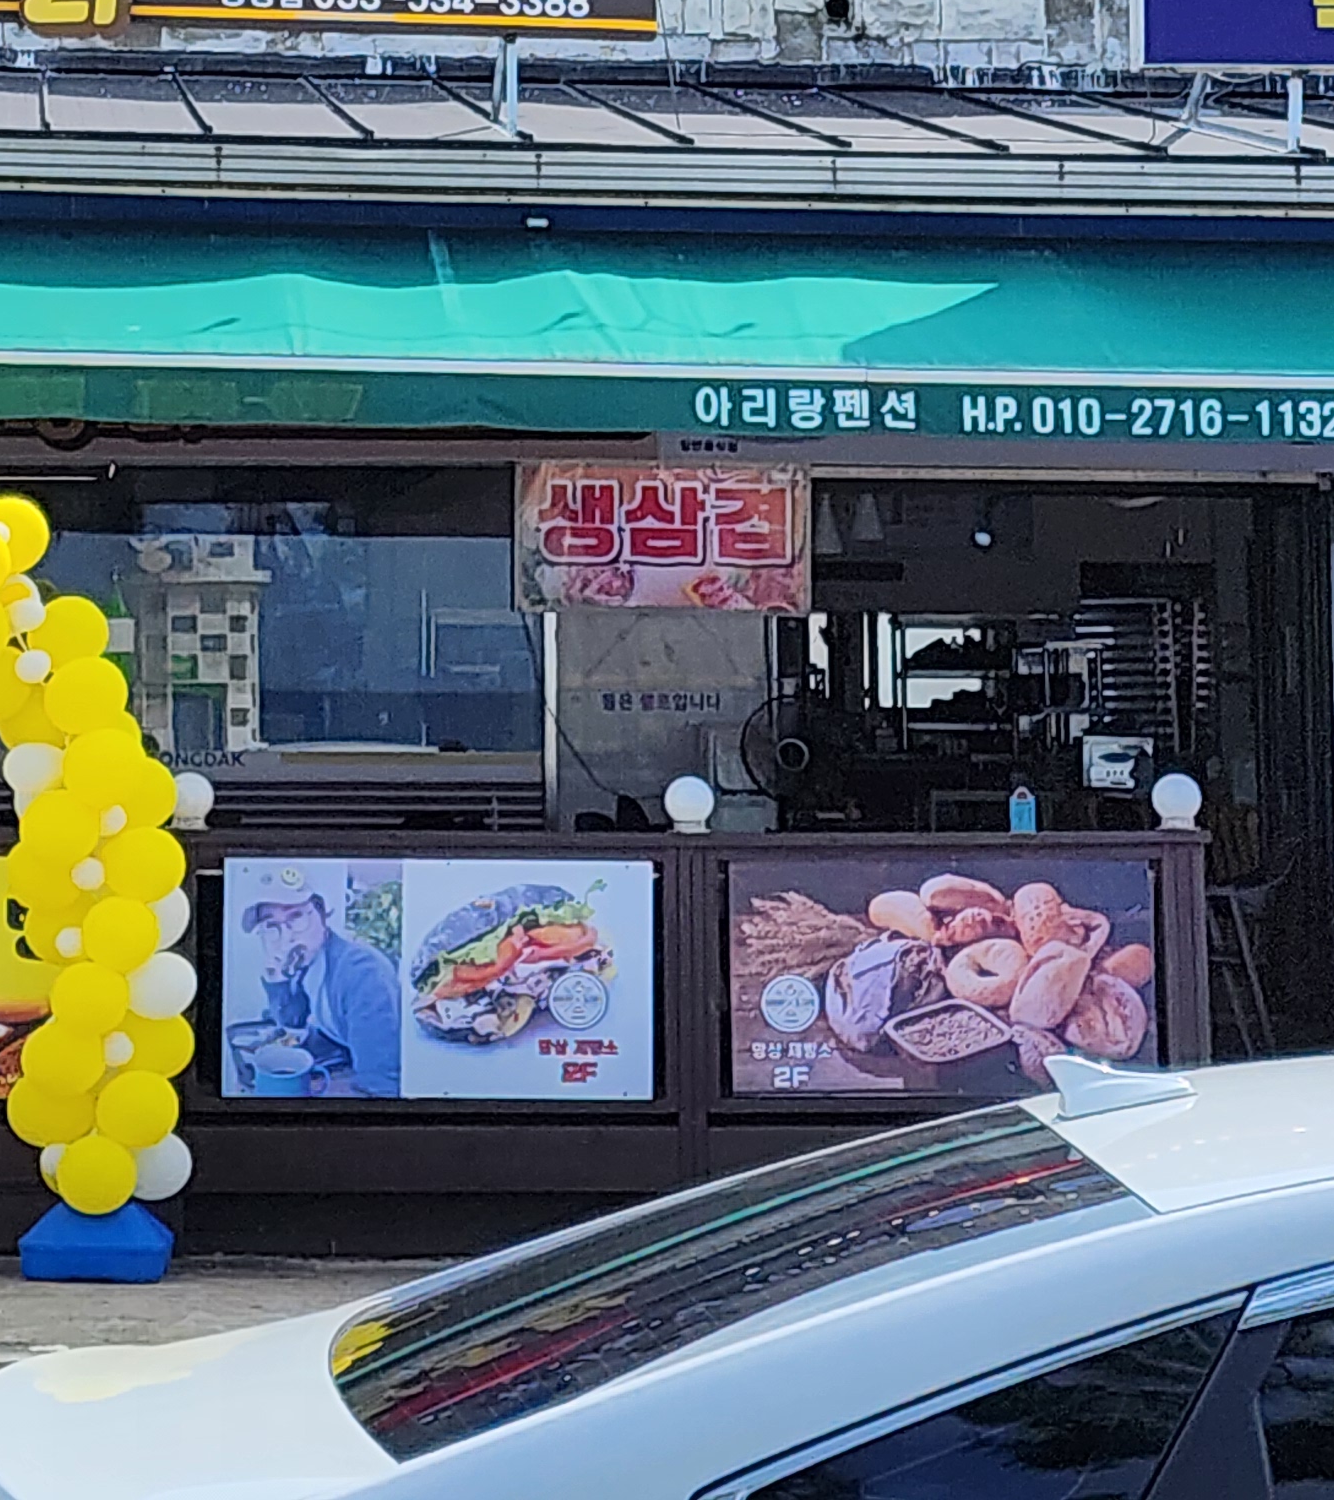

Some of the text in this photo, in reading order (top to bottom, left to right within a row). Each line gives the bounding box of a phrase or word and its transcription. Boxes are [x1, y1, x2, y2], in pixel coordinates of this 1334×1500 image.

[694, 385, 917, 431] 아리랑펜션
[538, 480, 790, 562] 생삼겹
[774, 1066, 809, 1088] 2F
